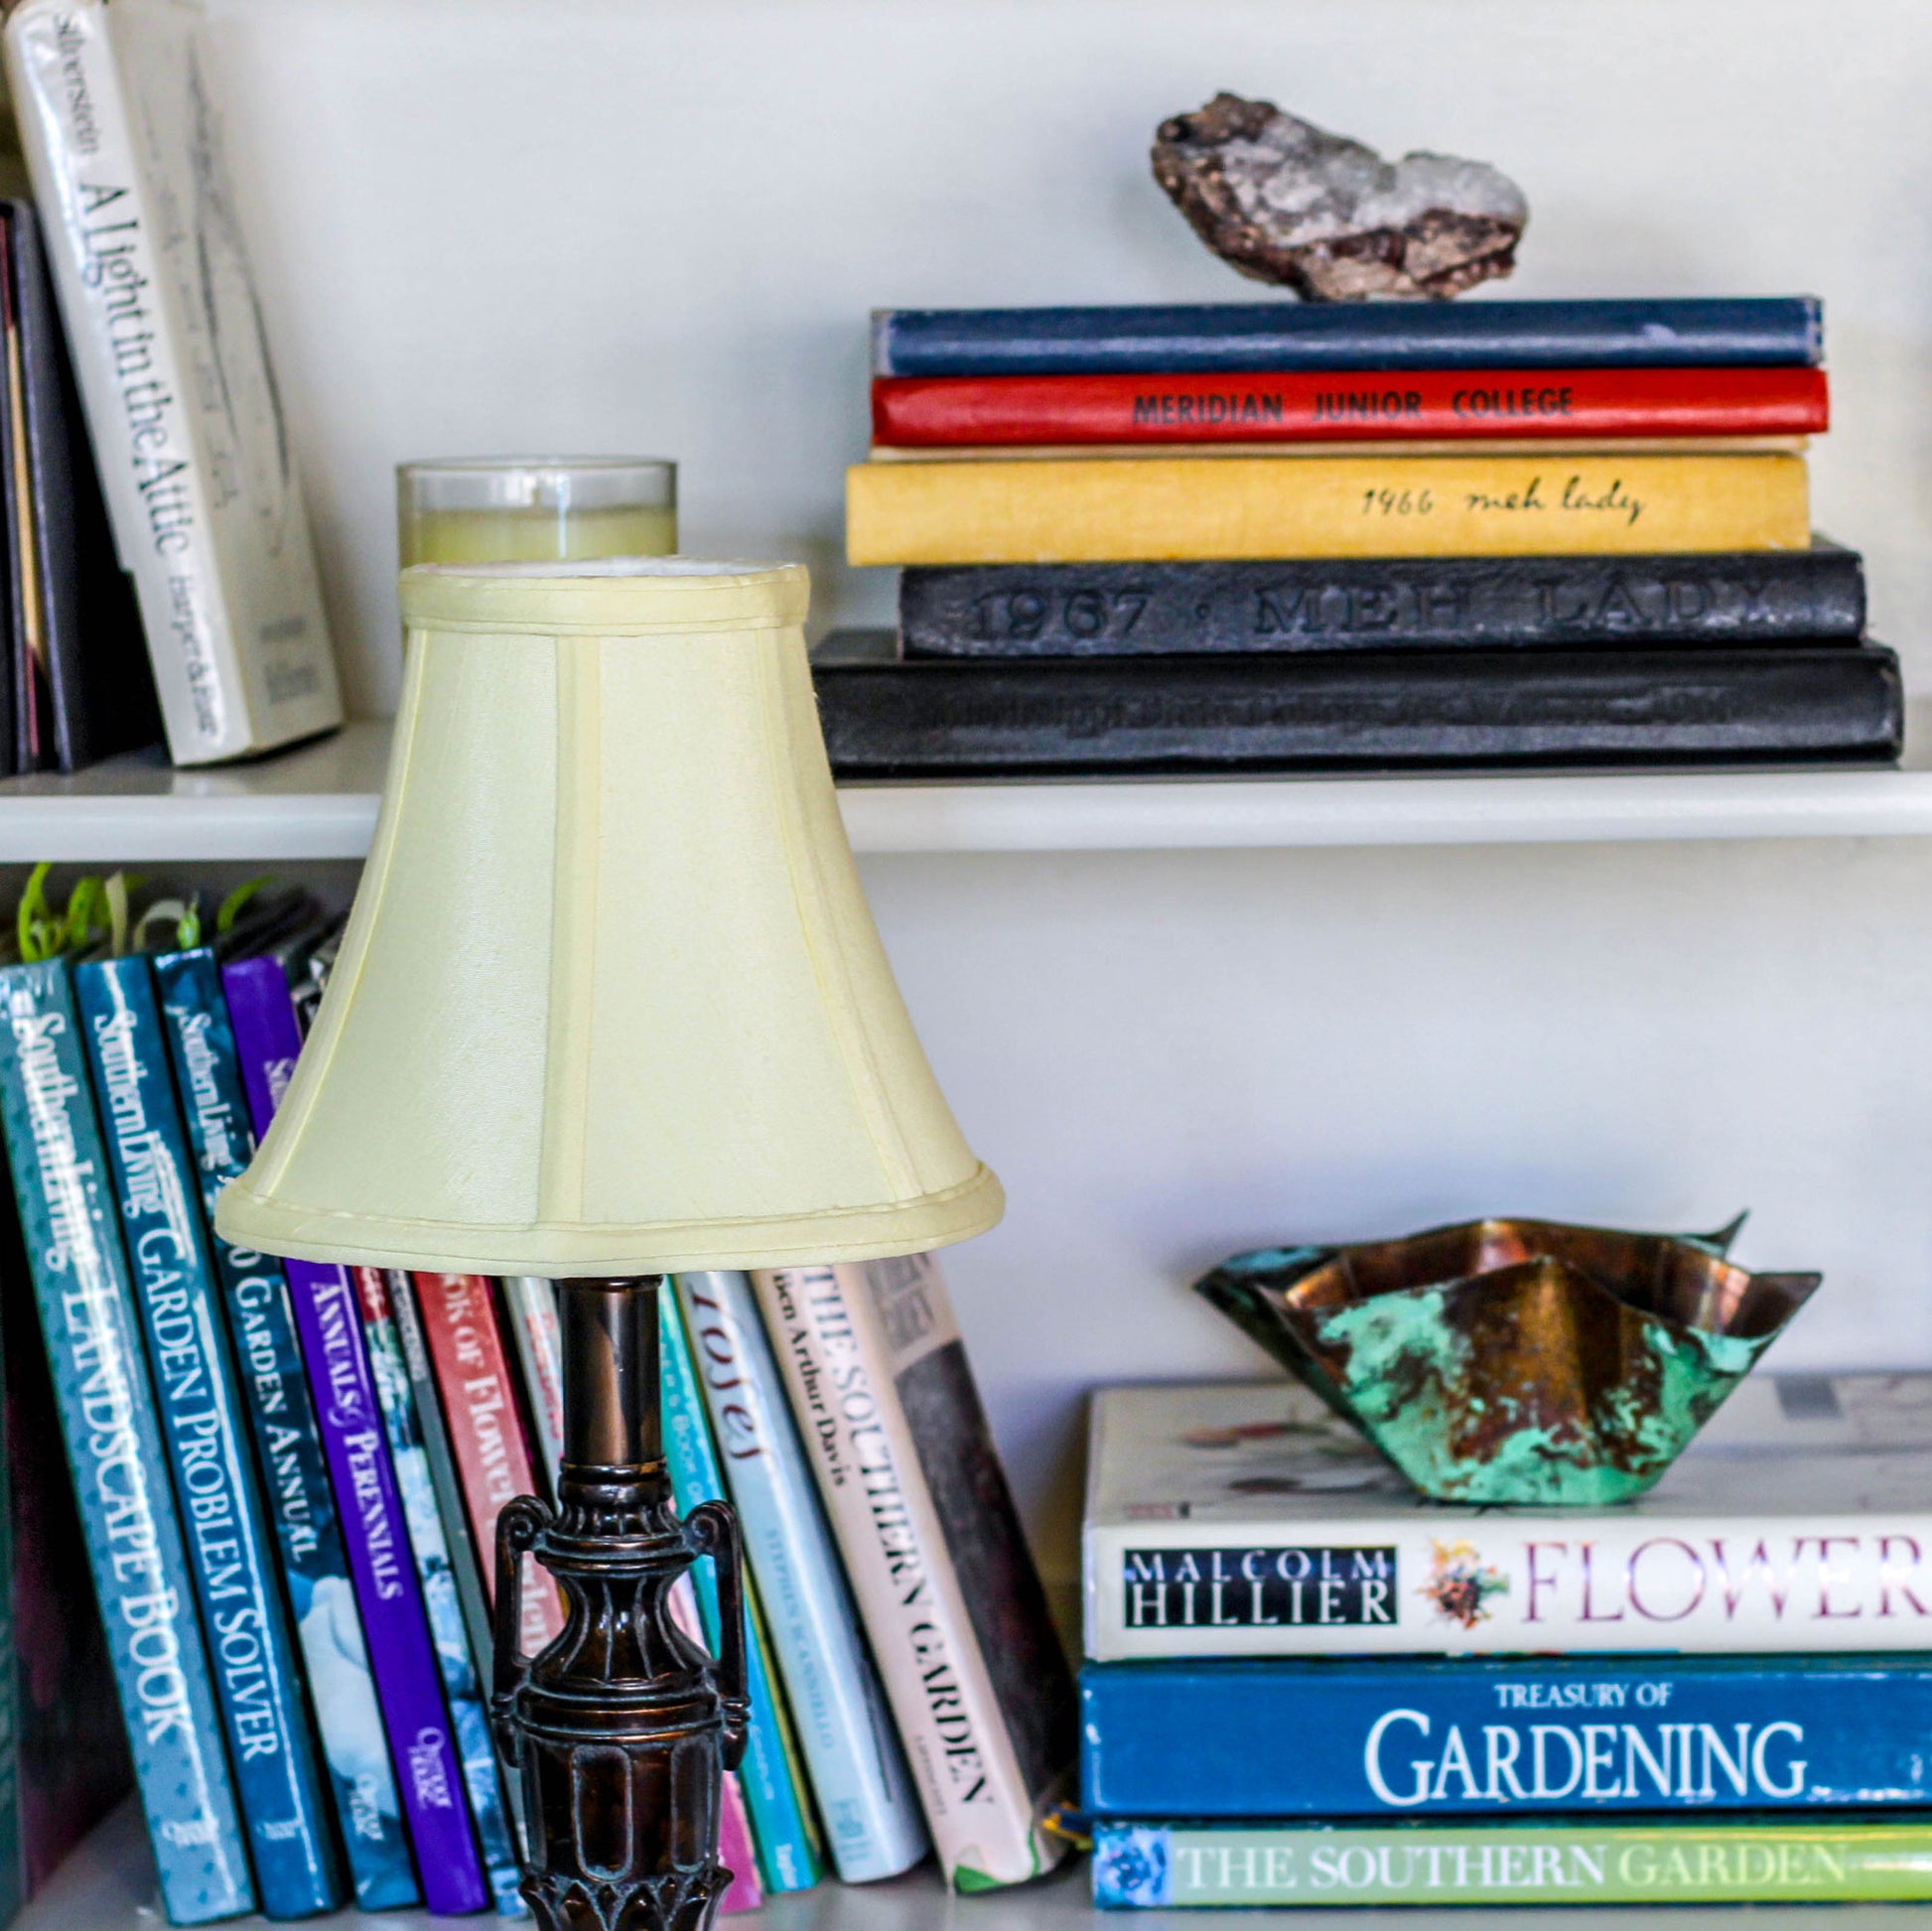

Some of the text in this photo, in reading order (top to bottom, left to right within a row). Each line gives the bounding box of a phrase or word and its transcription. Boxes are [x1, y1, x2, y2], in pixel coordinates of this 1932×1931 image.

[78, 182, 193, 556] A Light in the Attic
[1131, 387, 1574, 425] MERIDIAN JUNIOR COLLEGE
[1362, 487, 1434, 514] 1966
[969, 571, 1777, 641] 1967 MEH LADY
[235, 1276, 288, 1415] GARDEN
[264, 1424, 319, 1563] ANNUAL
[310, 1280, 362, 1416] ANNUALS
[343, 1428, 404, 1602] PERENNIALS
[788, 1328, 825, 1412] Arthur
[815, 1417, 852, 1487] Davis
[62, 1283, 162, 1584] LANDSCAPE
[120, 1586, 193, 1745] BOOK
[137, 1228, 207, 1402] GARDEN
[173, 1408, 250, 1601] PROBLEM
[212, 1607, 279, 1762] SOLVER
[802, 1264, 859, 1356] THE
[835, 1363, 933, 1606] SOUTHERN
[909, 1622, 996, 1803] GARDEN
[1130, 1550, 1388, 1582] MALCOLM
[1132, 1582, 1392, 1625] HILLIER
[1520, 1536, 1930, 1623] FLOWER
[1494, 1684, 1673, 1708] TREASURY OF
[1364, 1708, 1808, 1807] GARDENING
[1177, 1842, 1849, 1888] THE SOUTHERN GARDEN
